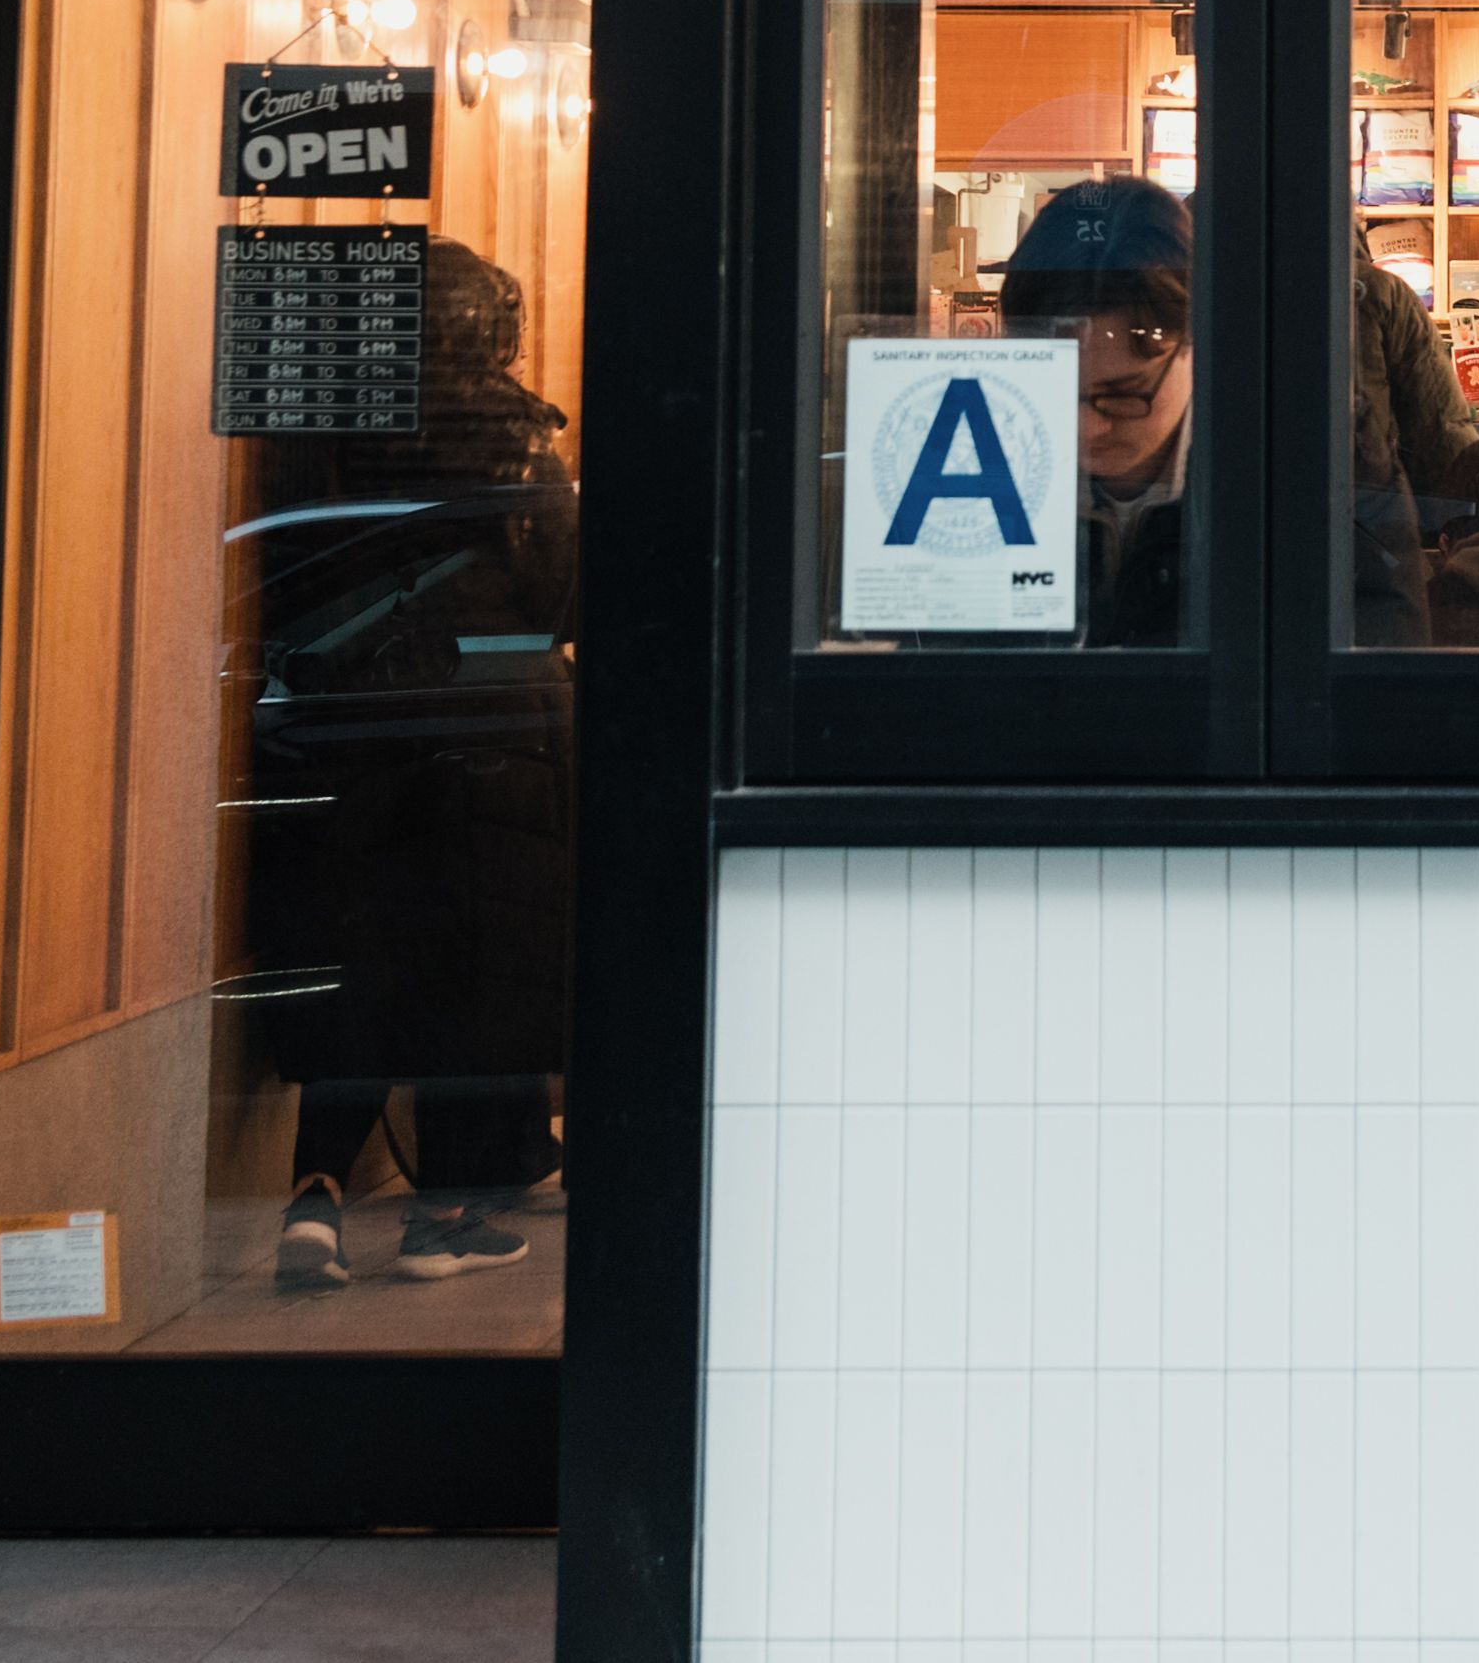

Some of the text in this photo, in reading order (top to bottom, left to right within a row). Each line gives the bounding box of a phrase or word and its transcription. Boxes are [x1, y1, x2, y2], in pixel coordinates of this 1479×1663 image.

[241, 80, 405, 124] Come in We're
[243, 125, 409, 182] OPEN
[224, 240, 421, 263] BUSINESS HOURS
[228, 268, 268, 282] MON
[321, 268, 339, 282] TO
[230, 292, 257, 306] TUE
[320, 293, 339, 307] TO
[229, 316, 263, 330] WED
[319, 317, 338, 331] TO
[228, 341, 258, 355] THU
[318, 341, 337, 355] TO
[872, 350, 1055, 362] SANITARY INSPECTION GRADE
[226, 365, 249, 379] FRI
[317, 366, 336, 379] TO
[225, 389, 252, 403] SAT
[316, 390, 336, 404] TO
[225, 413, 256, 427] SUN
[315, 414, 334, 428] TO
[882, 377, 1037, 546] A
[1011, 571, 1056, 587] NYC
